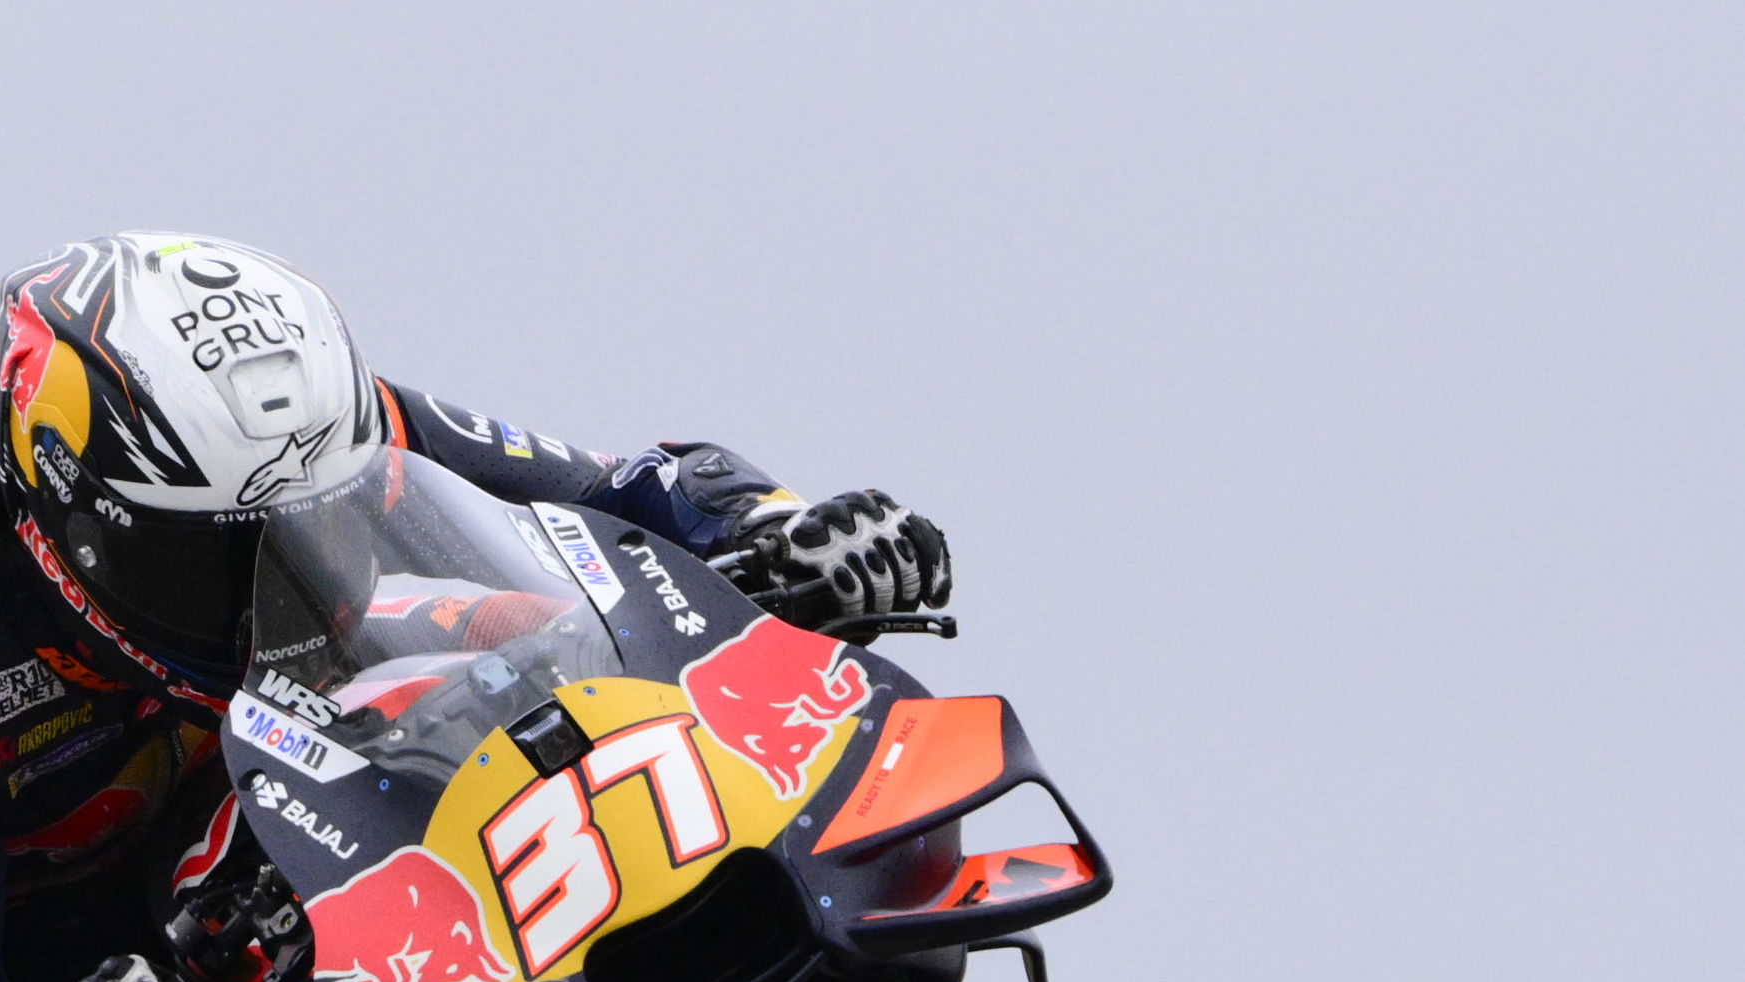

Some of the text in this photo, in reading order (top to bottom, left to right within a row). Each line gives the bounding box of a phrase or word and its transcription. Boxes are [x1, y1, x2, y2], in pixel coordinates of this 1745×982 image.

[170, 288, 286, 342] PONT
[192, 318, 305, 372] GRUP
[278, 499, 314, 516] YOU
[629, 545, 689, 611] BAJAJ
[255, 634, 327, 663] Norauto
[257, 667, 341, 728] WRS
[248, 711, 311, 760] Mobil
[280, 799, 359, 860] BAJAJ
[478, 712, 731, 982] 37
